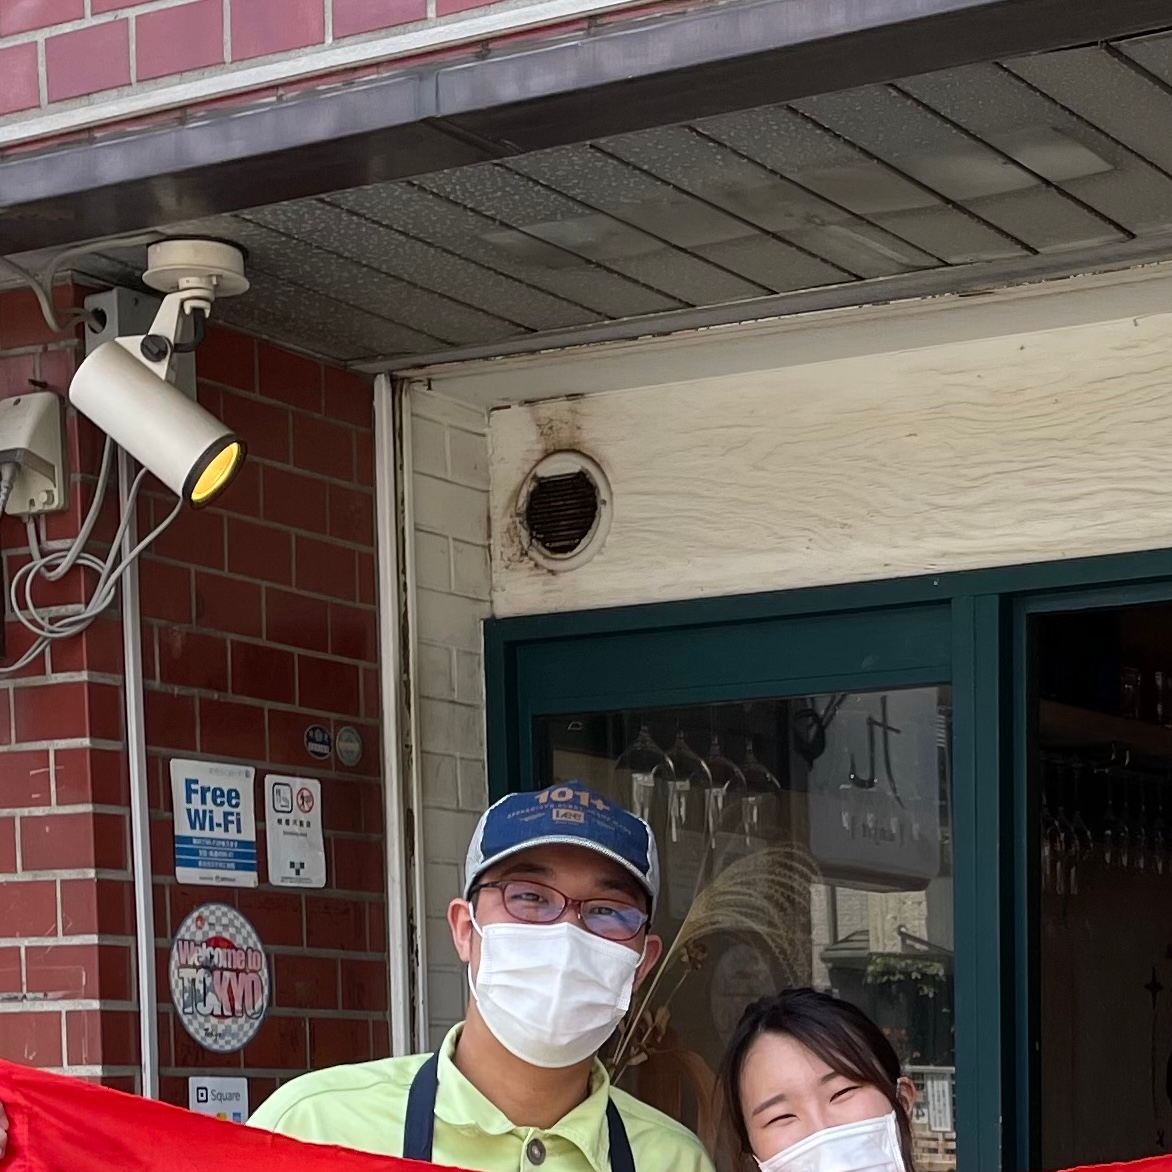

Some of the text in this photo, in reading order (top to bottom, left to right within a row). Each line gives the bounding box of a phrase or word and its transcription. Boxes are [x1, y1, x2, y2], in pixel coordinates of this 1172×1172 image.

[184, 777, 241, 809] Free
[185, 807, 243, 834] Wi-Fi
[176, 938, 263, 972] Welcome to
[178, 967, 264, 1019] TOKYO
[210, 1088, 241, 1102] Square
